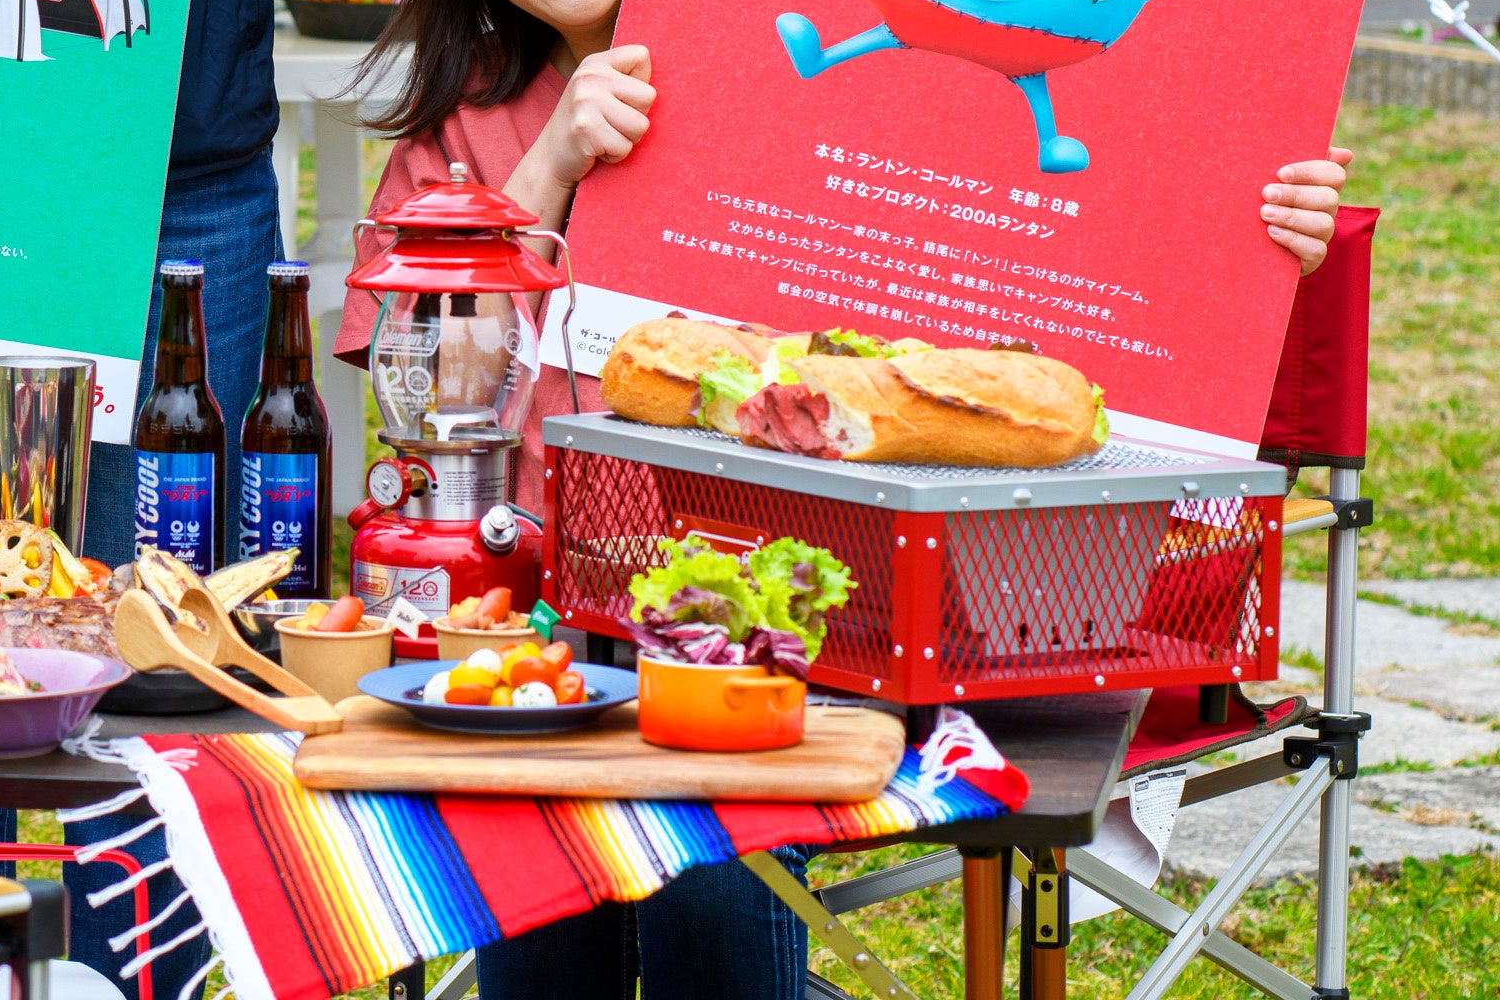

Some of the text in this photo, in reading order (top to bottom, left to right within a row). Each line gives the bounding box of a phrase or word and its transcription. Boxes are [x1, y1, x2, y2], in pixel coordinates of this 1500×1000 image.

[1008, 187, 1080, 218] 年齢：8歳
[777, 281, 1044, 356] 都会の空気で体調を崩しているため自宅待。
[137, 456, 160, 524] COOL
[242, 456, 262, 524] COOL
